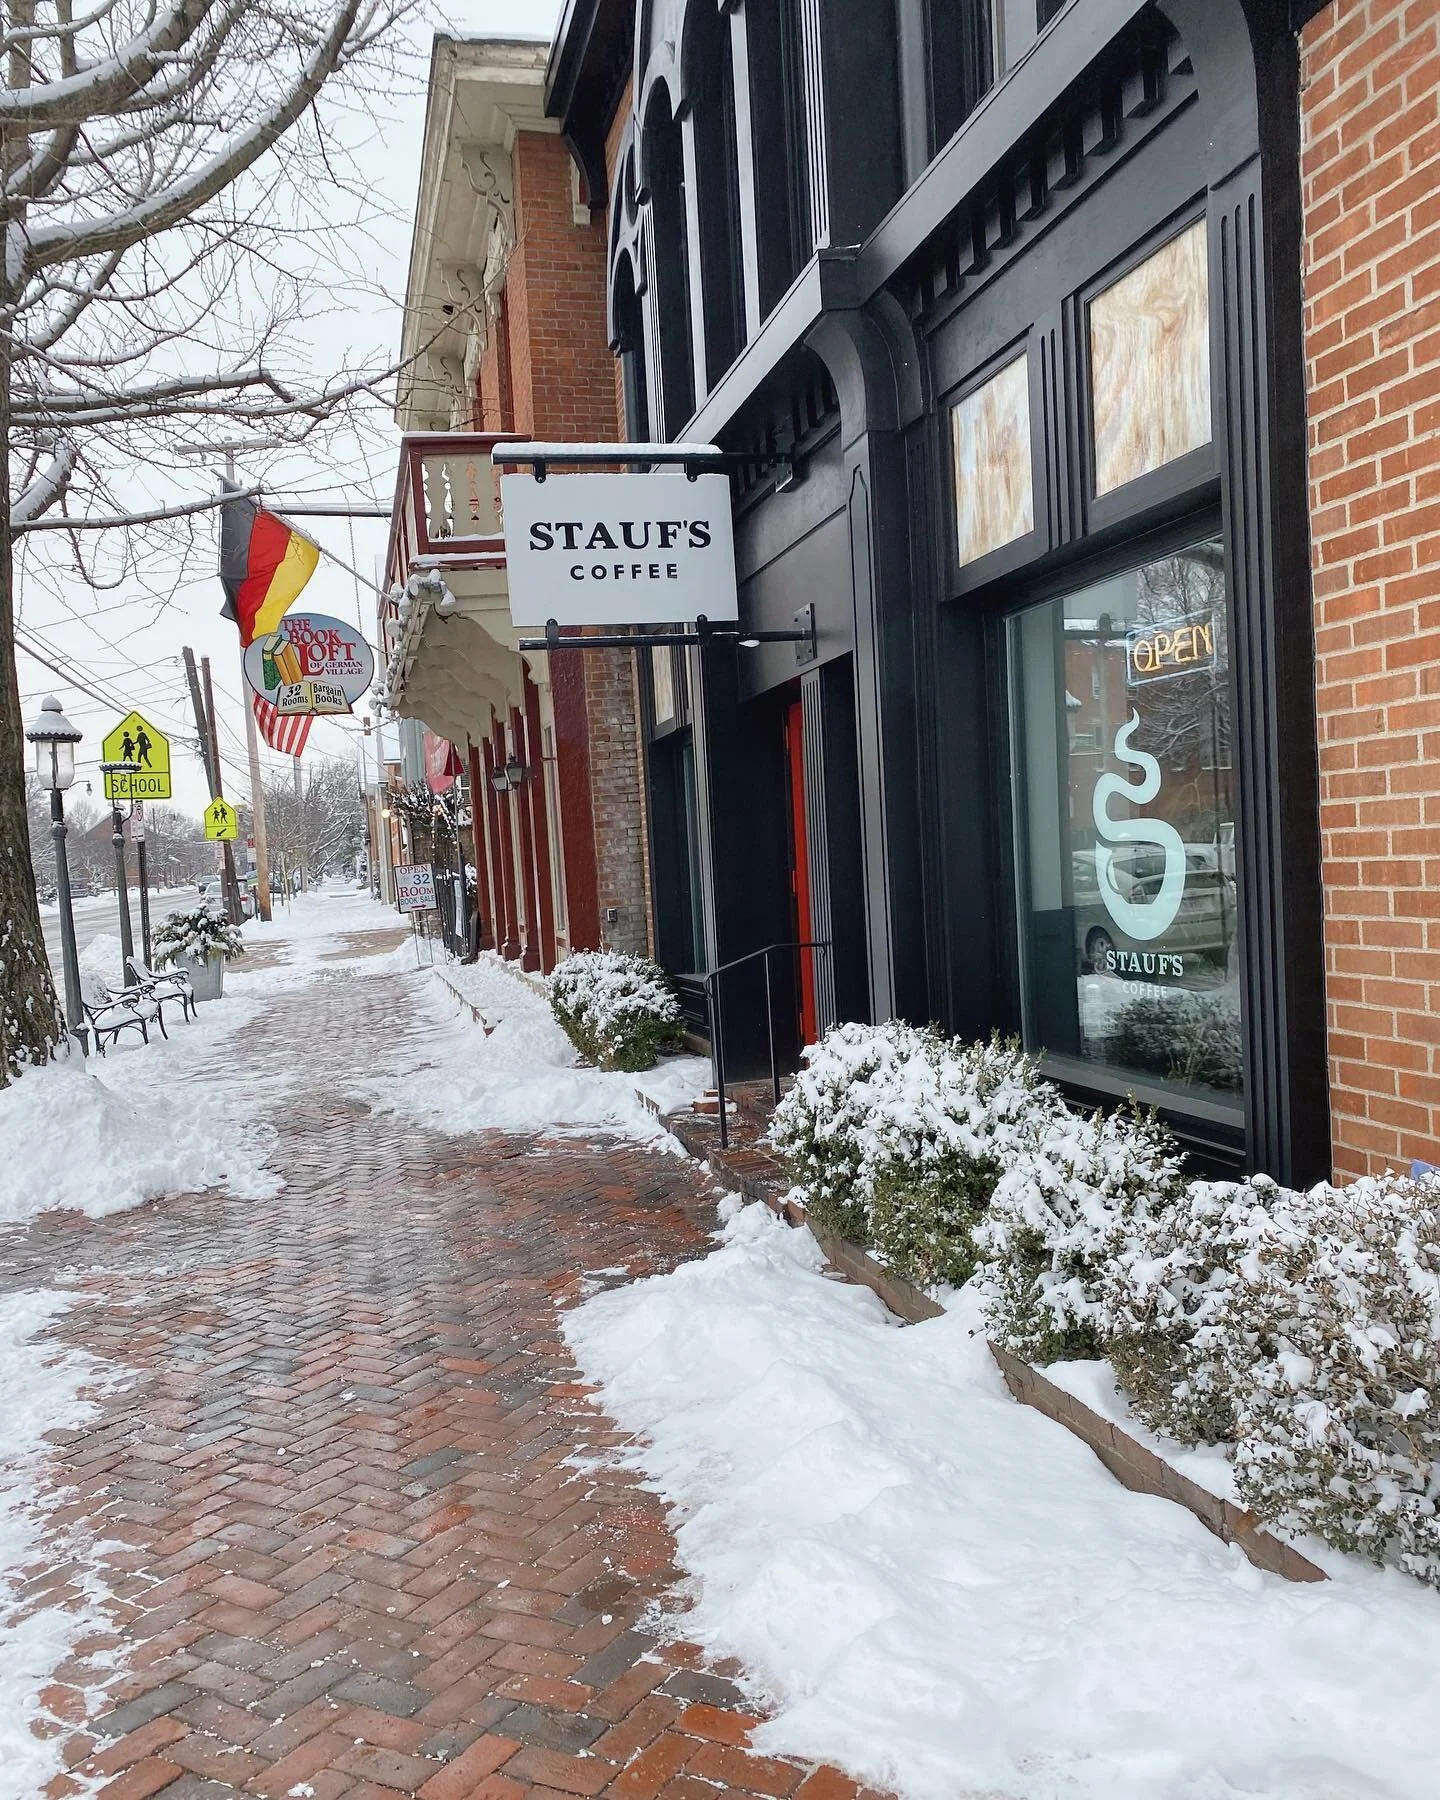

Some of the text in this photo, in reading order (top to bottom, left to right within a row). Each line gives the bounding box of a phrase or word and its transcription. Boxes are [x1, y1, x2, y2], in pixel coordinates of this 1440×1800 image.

[529, 520, 712, 551] STAUF'S
[570, 563, 678, 581] COFFEE
[281, 618, 311, 631] THE
[288, 629, 342, 645] BOOK
[1134, 624, 1213, 672] OPEN
[293, 642, 357, 676] LOFT
[310, 661, 323, 669] OF
[325, 668, 364, 676] VILLAGE
[286, 684, 302, 698] 32
[313, 683, 342, 697] Bargain
[282, 695, 309, 707] Rooms
[315, 693, 343, 706] Books
[112, 778, 166, 793] SCHOOL
[400, 864, 428, 875] OPEN
[413, 873, 431, 885] 32
[399, 886, 434, 898] ROOM
[400, 895, 435, 906] BOOK SALE
[1106, 949, 1184, 977] STAUF'S
[1122, 981, 1168, 999] COFFEE
